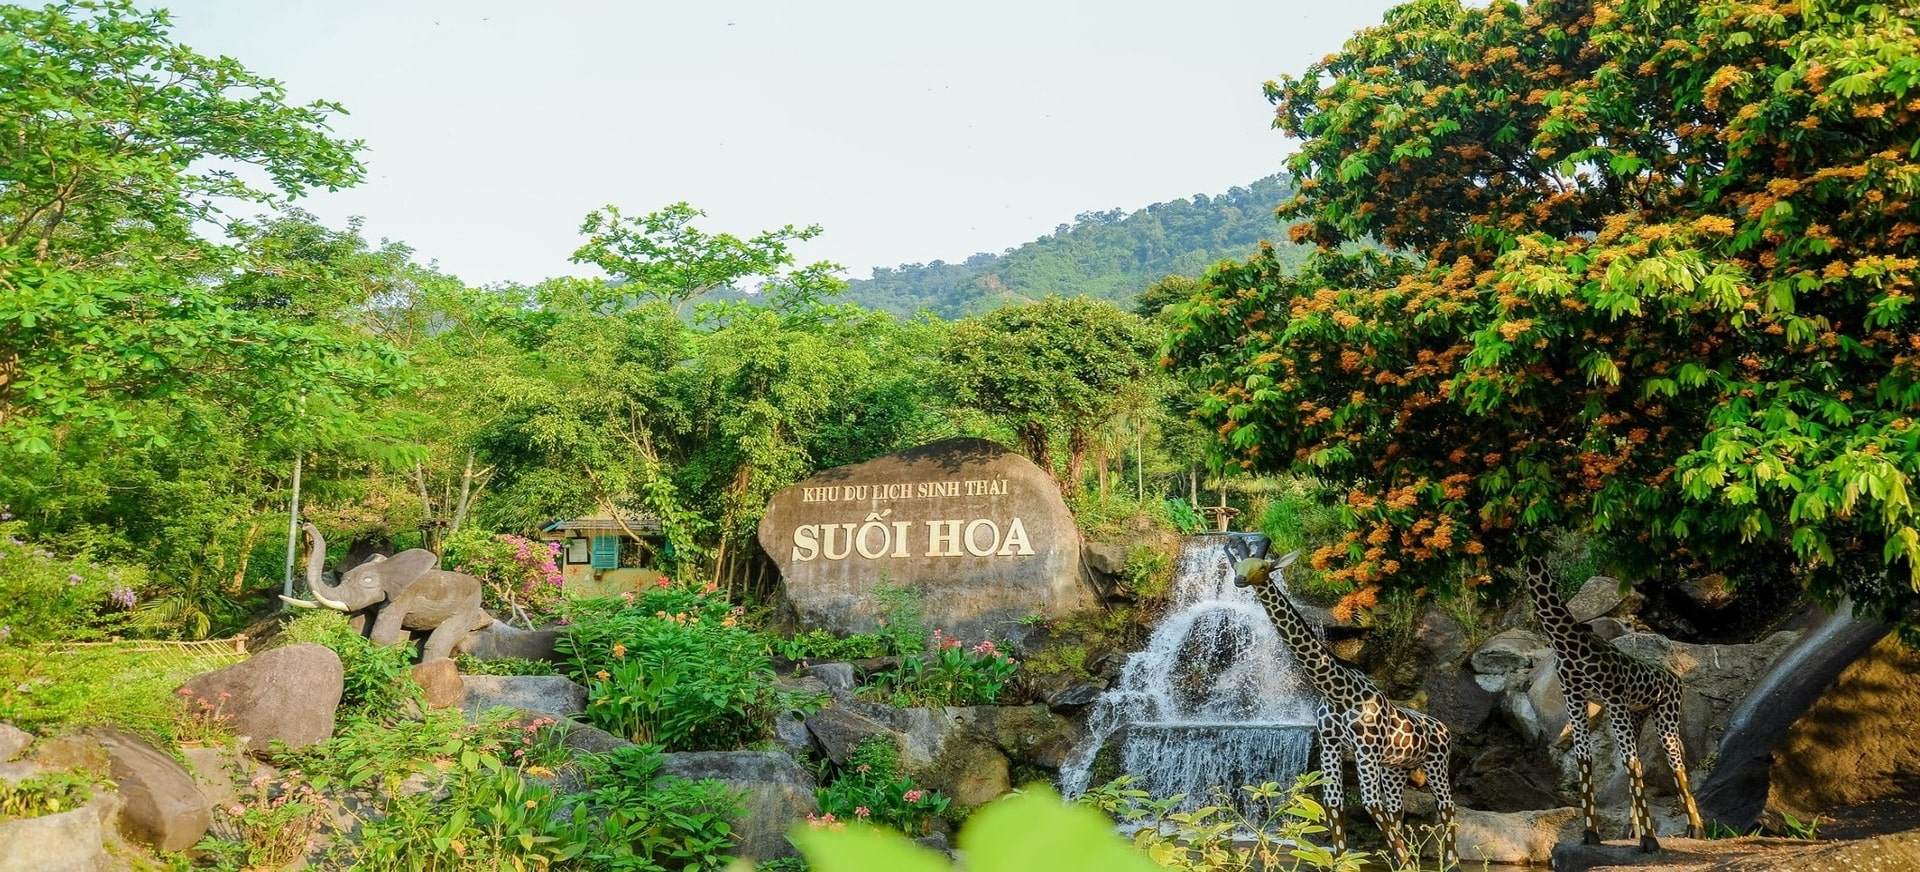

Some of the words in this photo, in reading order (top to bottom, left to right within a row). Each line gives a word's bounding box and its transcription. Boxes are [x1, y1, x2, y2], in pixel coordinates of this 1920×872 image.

[803, 486, 839, 502] KHU
[844, 485, 867, 500] DU
[872, 484, 913, 503] LỊCH
[917, 481, 960, 498] SINH
[965, 474, 1008, 497] THÁI
[792, 509, 912, 562] SUỐI
[925, 517, 1035, 557] HOA
